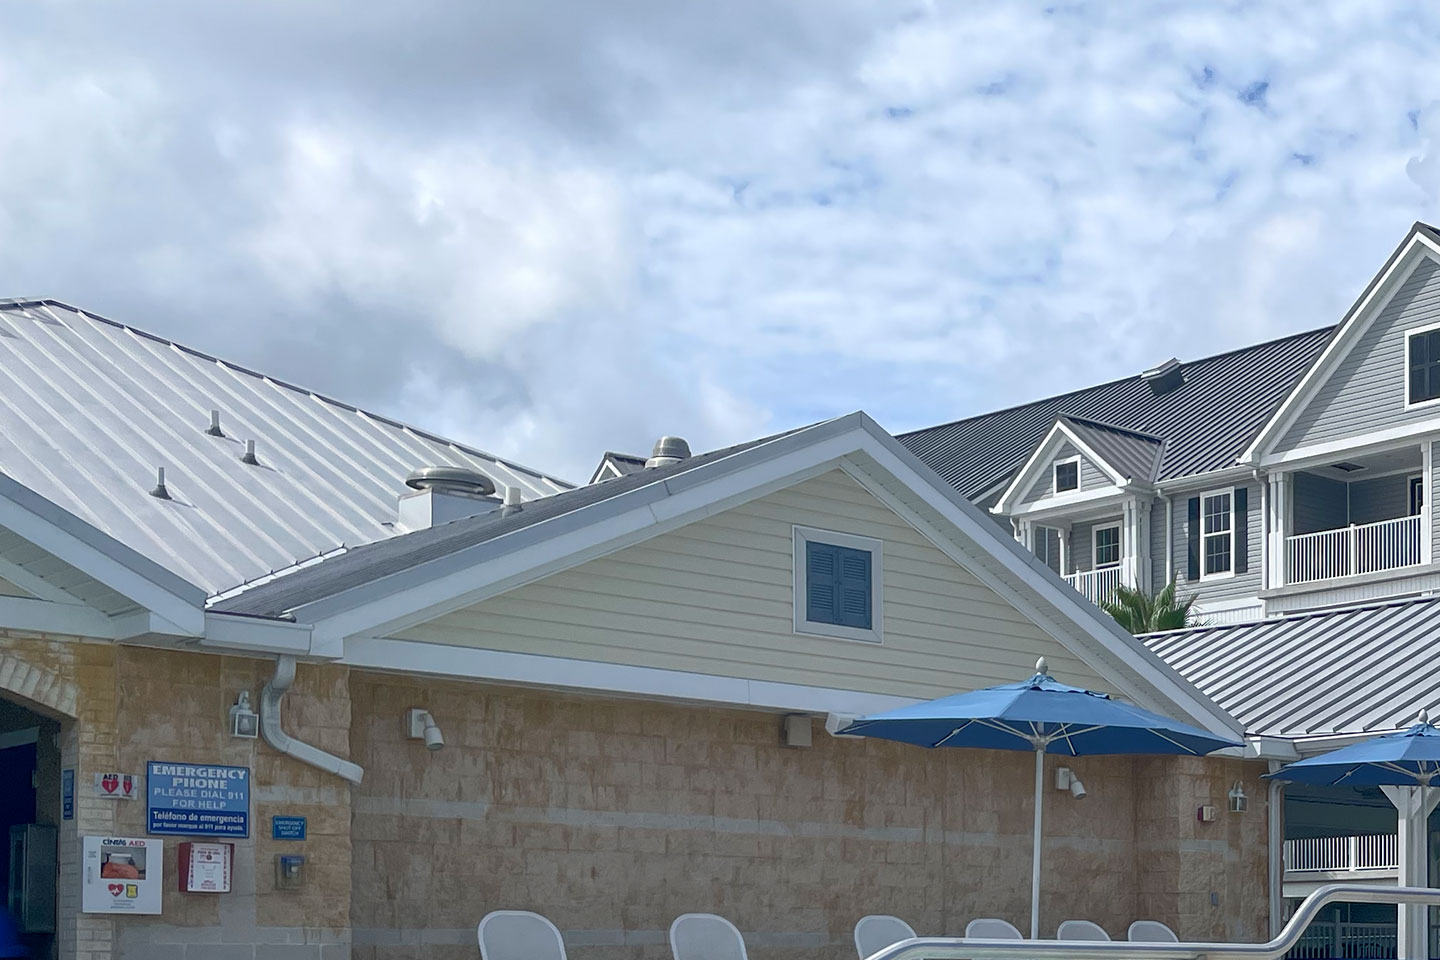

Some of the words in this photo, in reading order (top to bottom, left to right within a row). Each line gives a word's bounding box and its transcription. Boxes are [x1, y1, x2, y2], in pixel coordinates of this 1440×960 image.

[152, 765, 246, 780] EMERGENCY
[172, 777, 228, 789] PHONE
[154, 787, 198, 798] PLEASE
[201, 790, 225, 799] DIAL
[228, 791, 245, 800] 911
[172, 799, 196, 808] FOR
[198, 800, 227, 809] HELP
[153, 811, 187, 821] Teléfono
[188, 813, 198, 821] de
[200, 814, 244, 825] emergencia
